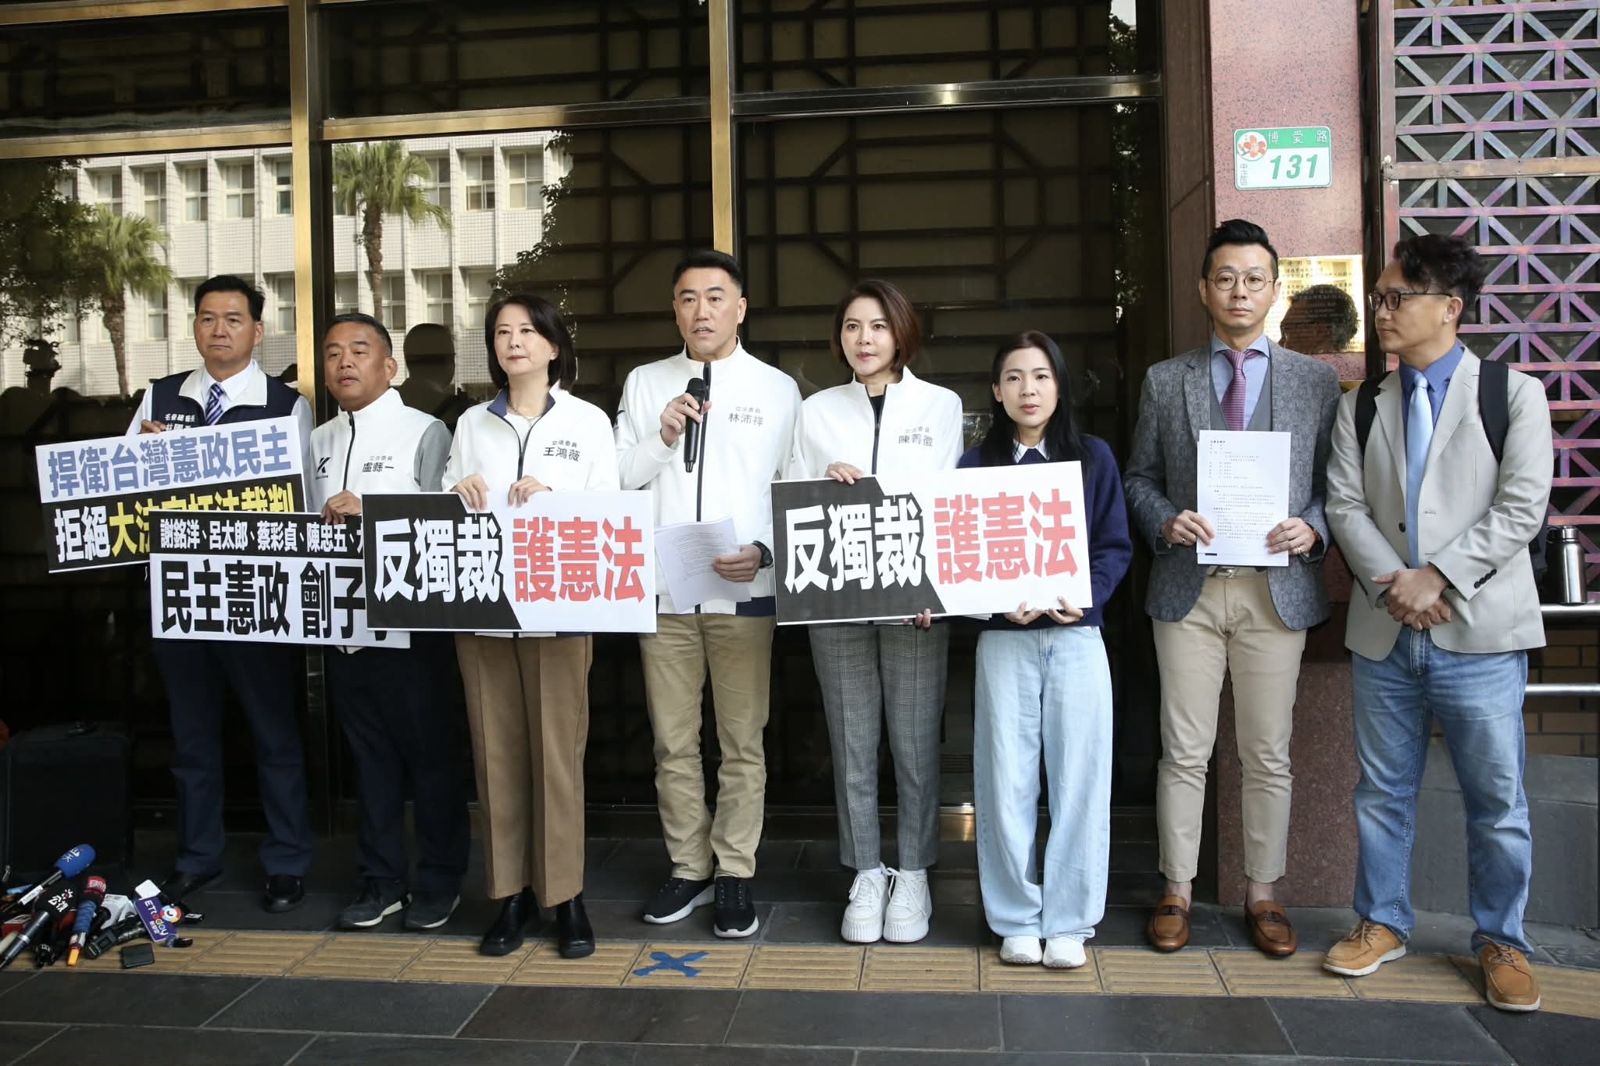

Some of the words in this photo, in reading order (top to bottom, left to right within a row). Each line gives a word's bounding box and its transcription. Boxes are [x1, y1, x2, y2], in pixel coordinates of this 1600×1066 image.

[1270, 154, 1318, 179] 131
[48, 425, 292, 498] 捍衛台灣憲政民主
[54, 482, 295, 563] 拒絕大法判
[374, 516, 503, 603] 反獨裁
[512, 516, 647, 603] 護憲法
[784, 496, 923, 595] 反獨裁
[934, 488, 1079, 585] 護憲法
[300, 561, 387, 642] 劊子
